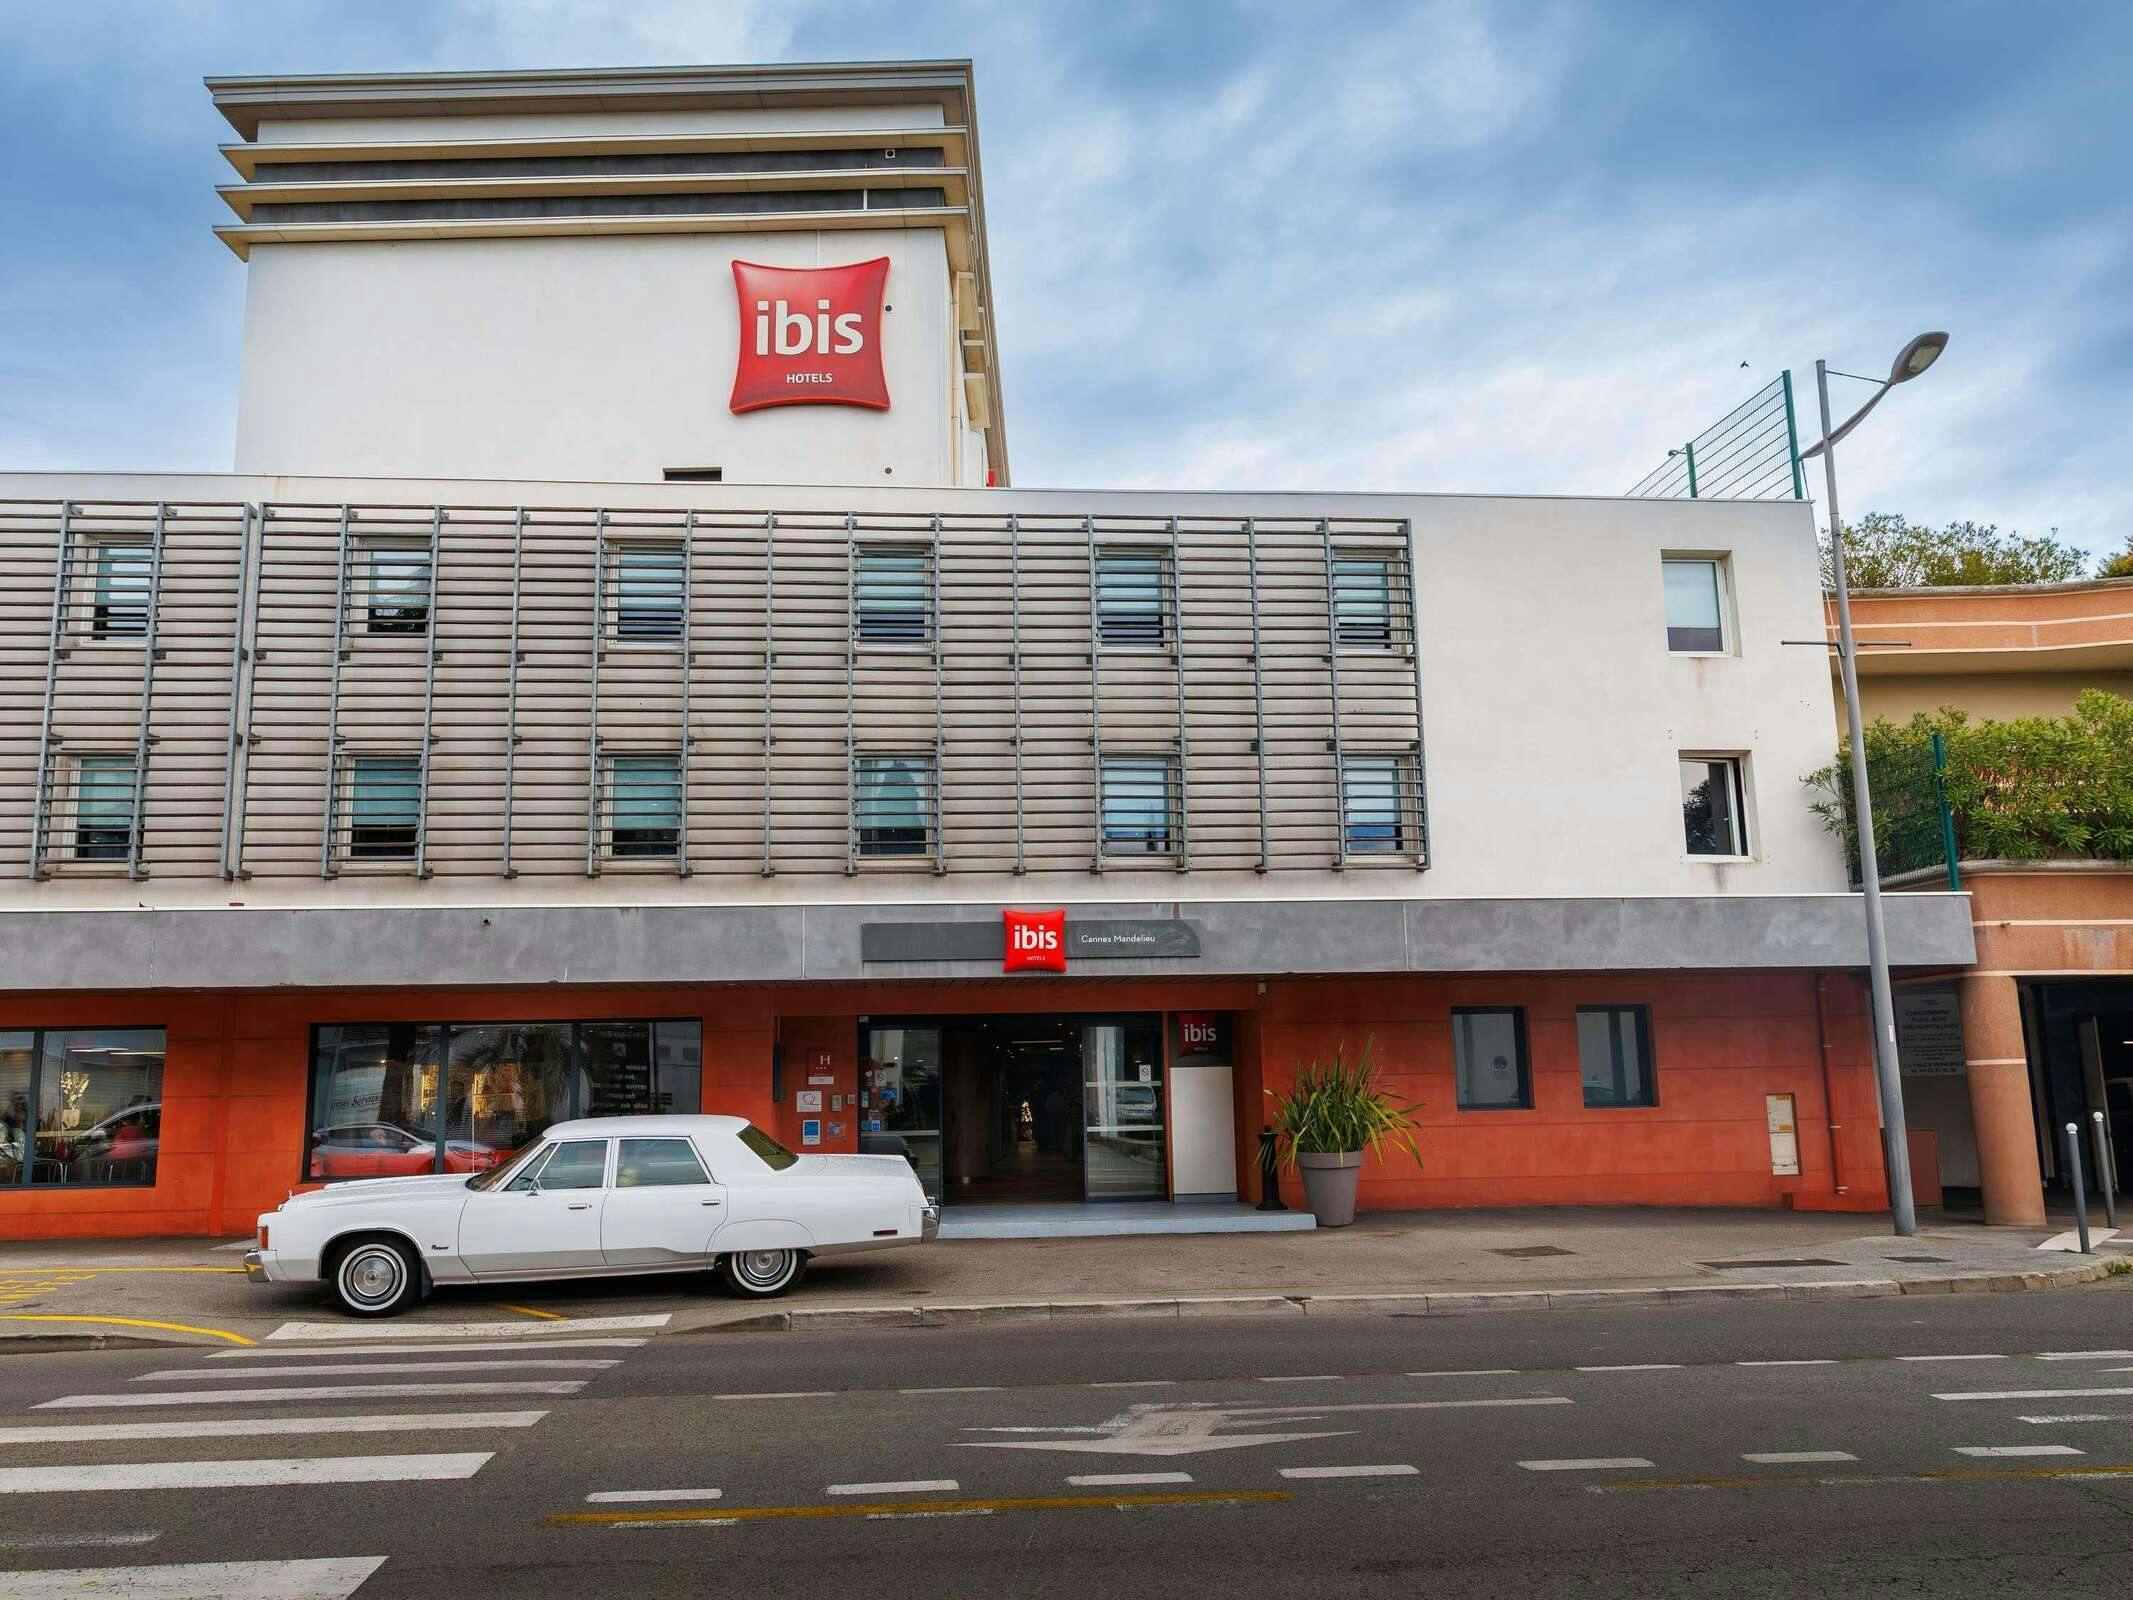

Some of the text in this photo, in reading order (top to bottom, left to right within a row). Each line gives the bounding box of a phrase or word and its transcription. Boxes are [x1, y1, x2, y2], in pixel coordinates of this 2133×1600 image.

[756, 299, 864, 356] ibis
[786, 373, 833, 384] HOTELS
[1014, 924, 1058, 950] ibis
[1081, 934, 1156, 943] Cannes Mandelieu
[1184, 1023, 1217, 1042] ibis
[820, 1055, 831, 1065] H
